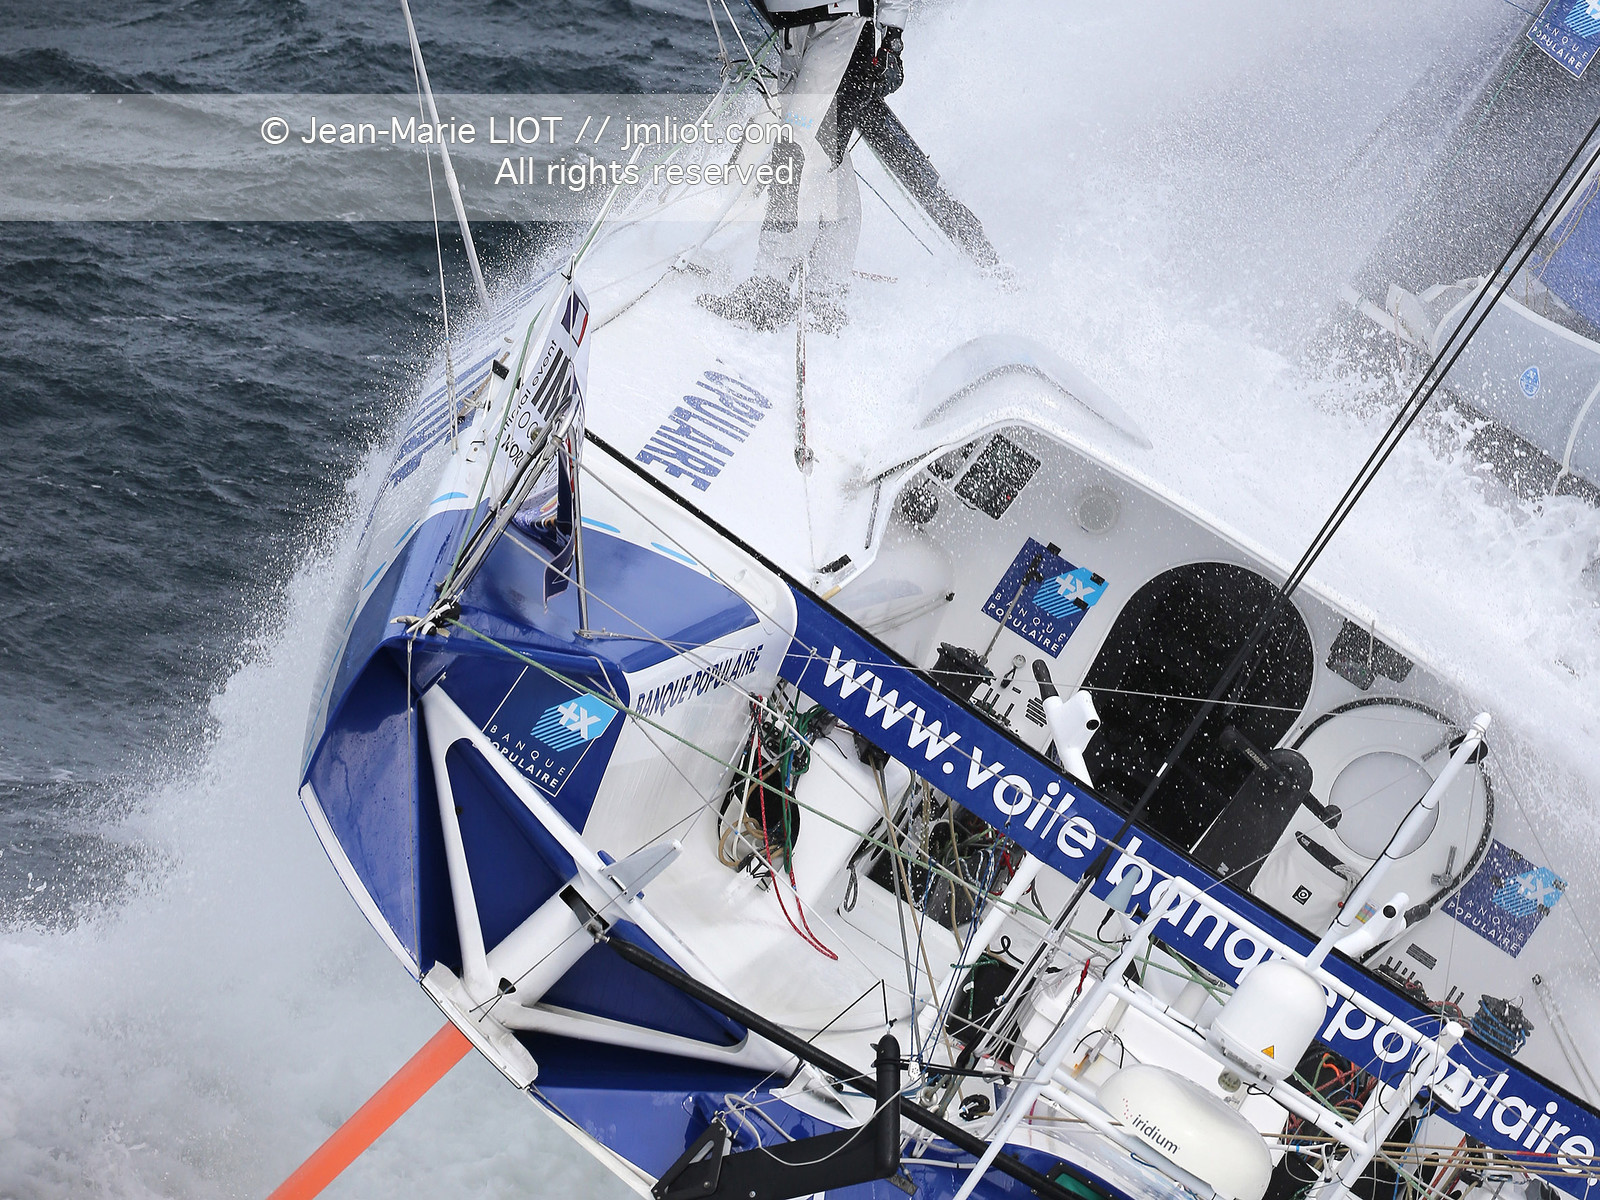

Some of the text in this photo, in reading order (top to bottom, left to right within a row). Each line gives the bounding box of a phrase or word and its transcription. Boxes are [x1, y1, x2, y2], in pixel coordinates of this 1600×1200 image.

[532, 339, 558, 387] event
[635, 360, 773, 492] OPULAIRE
[995, 592, 1067, 642] BANQUE
[635, 644, 764, 720] BANQUE POPULAIRE
[490, 724, 566, 776] BANQUE
[1447, 901, 1521, 953] POPULAIRE
[1131, 1114, 1179, 1155] iridium
